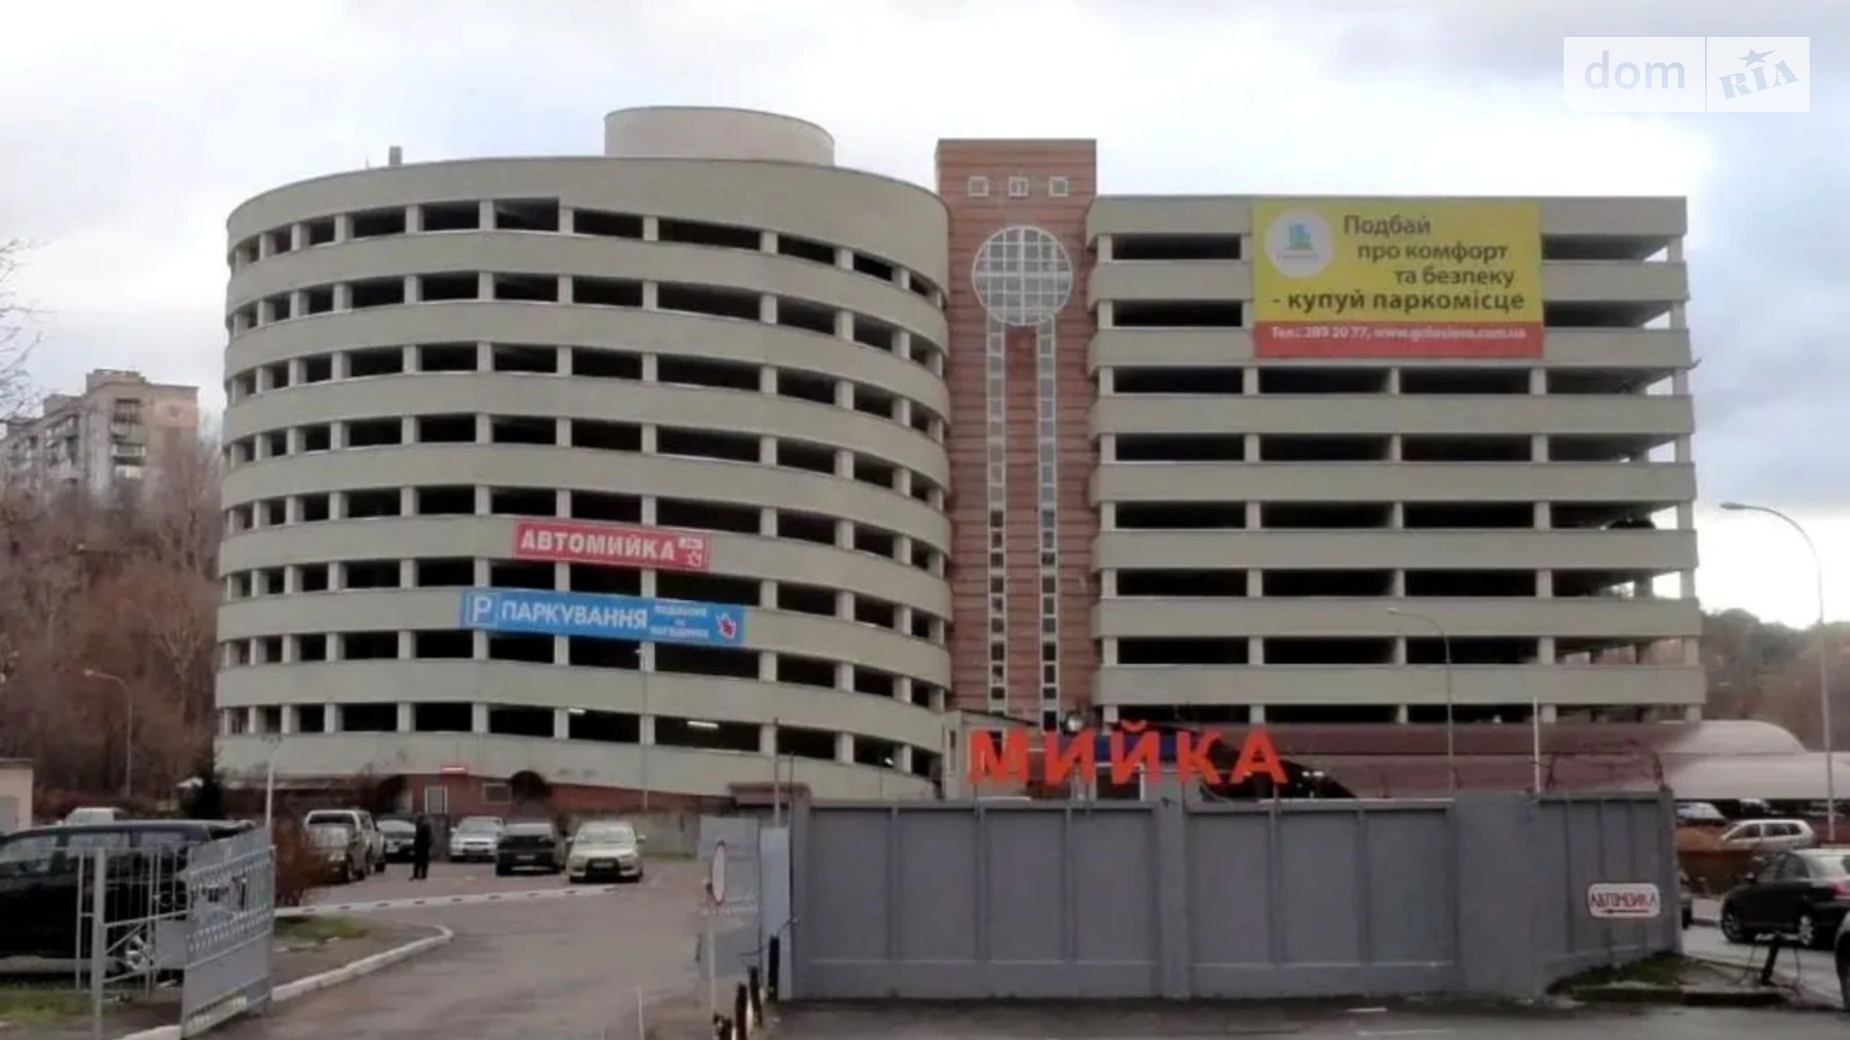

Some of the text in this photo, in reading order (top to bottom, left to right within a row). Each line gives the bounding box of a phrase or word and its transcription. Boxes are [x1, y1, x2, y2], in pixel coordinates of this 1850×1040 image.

[1343, 214, 1431, 236] Подбай
[1357, 240, 1509, 263] про комфорт
[1394, 265, 1515, 288] та безпеку
[1287, 290, 1365, 314] купуй
[1372, 291, 1526, 315] паркомісце
[520, 528, 676, 561] АВТОМИЙКА
[501, 600, 649, 630] ПАРКУВАННЯ
[968, 719, 1289, 785] МИЙКА
